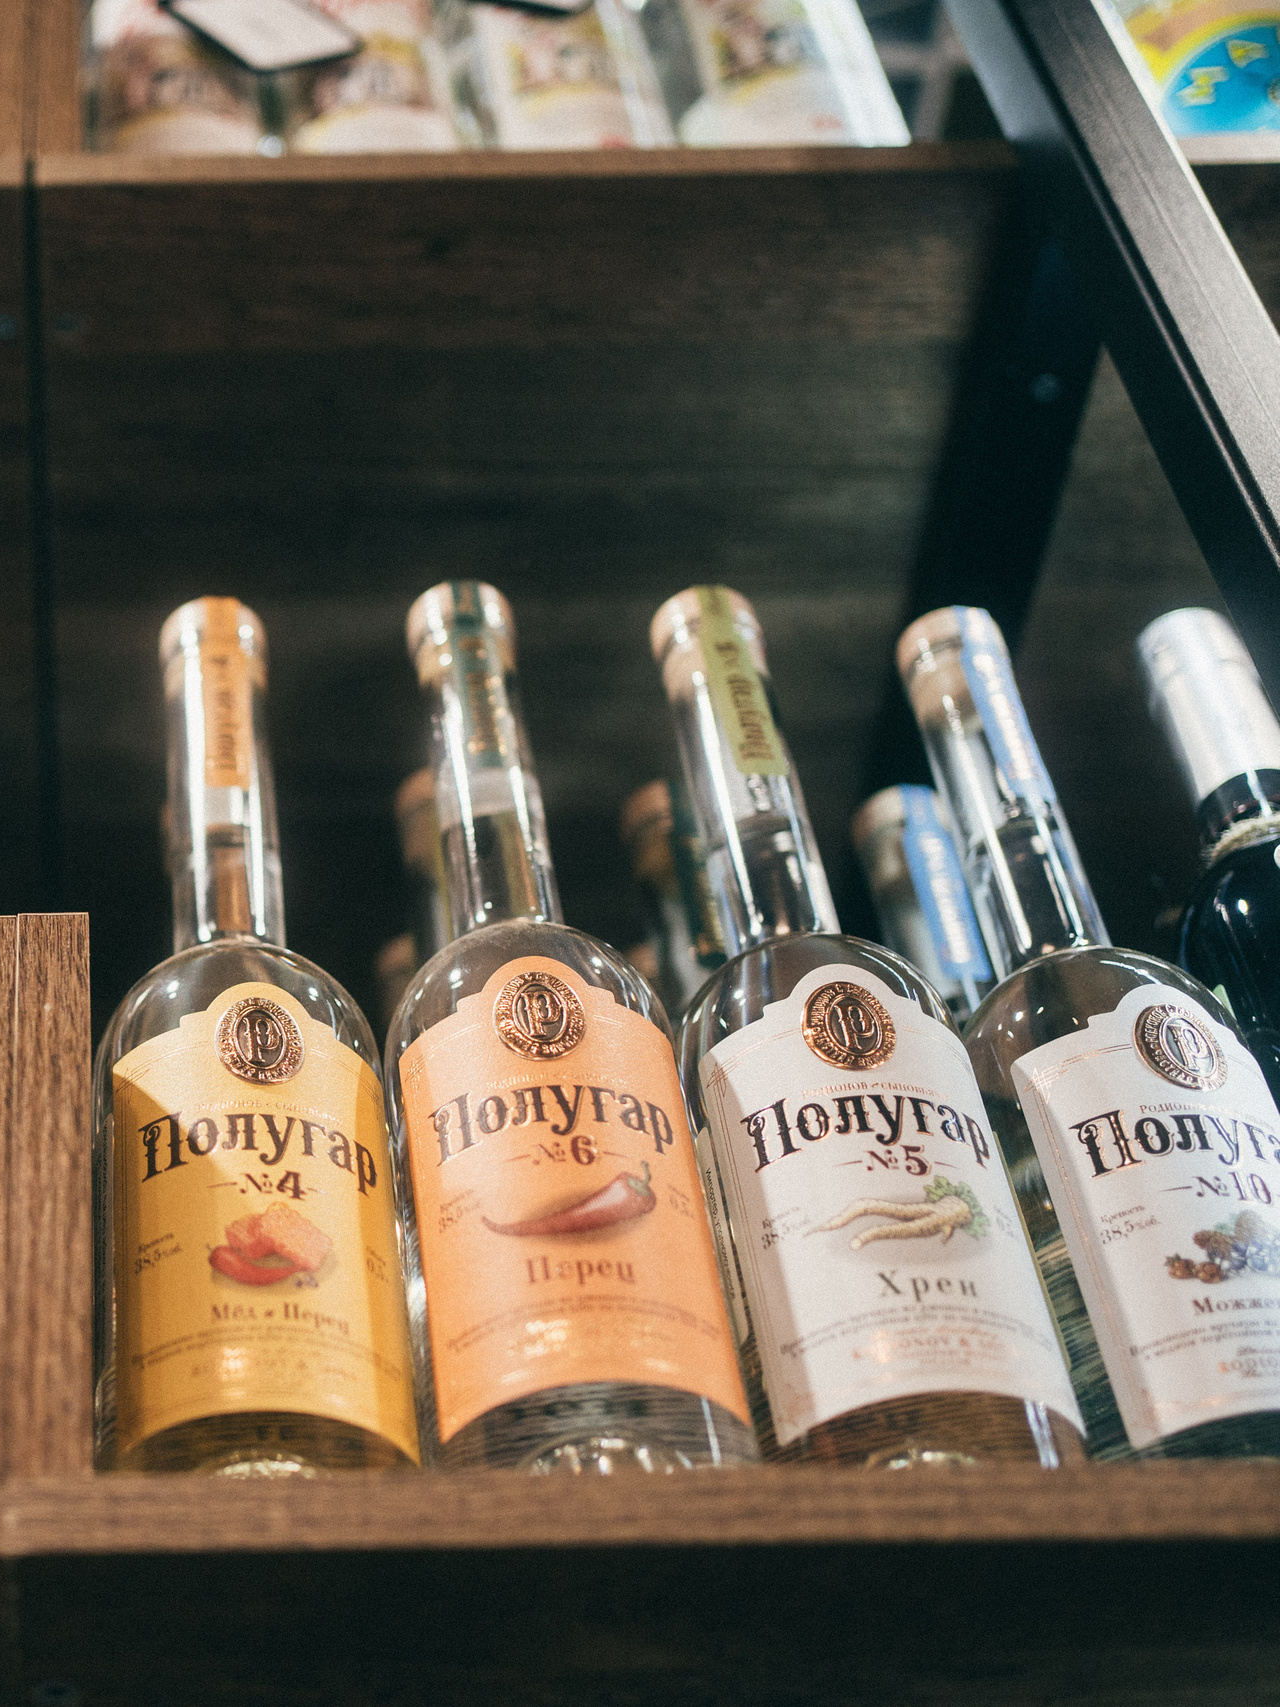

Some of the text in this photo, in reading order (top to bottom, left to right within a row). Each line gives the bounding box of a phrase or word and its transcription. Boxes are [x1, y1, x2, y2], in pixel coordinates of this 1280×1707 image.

[138, 1110, 378, 1197] Полугар
[428, 1084, 675, 1167] Полугар
[740, 1095, 990, 1174] Полугар
[526, 1256, 636, 1286] Перец
[877, 1269, 978, 1303] Хрен
